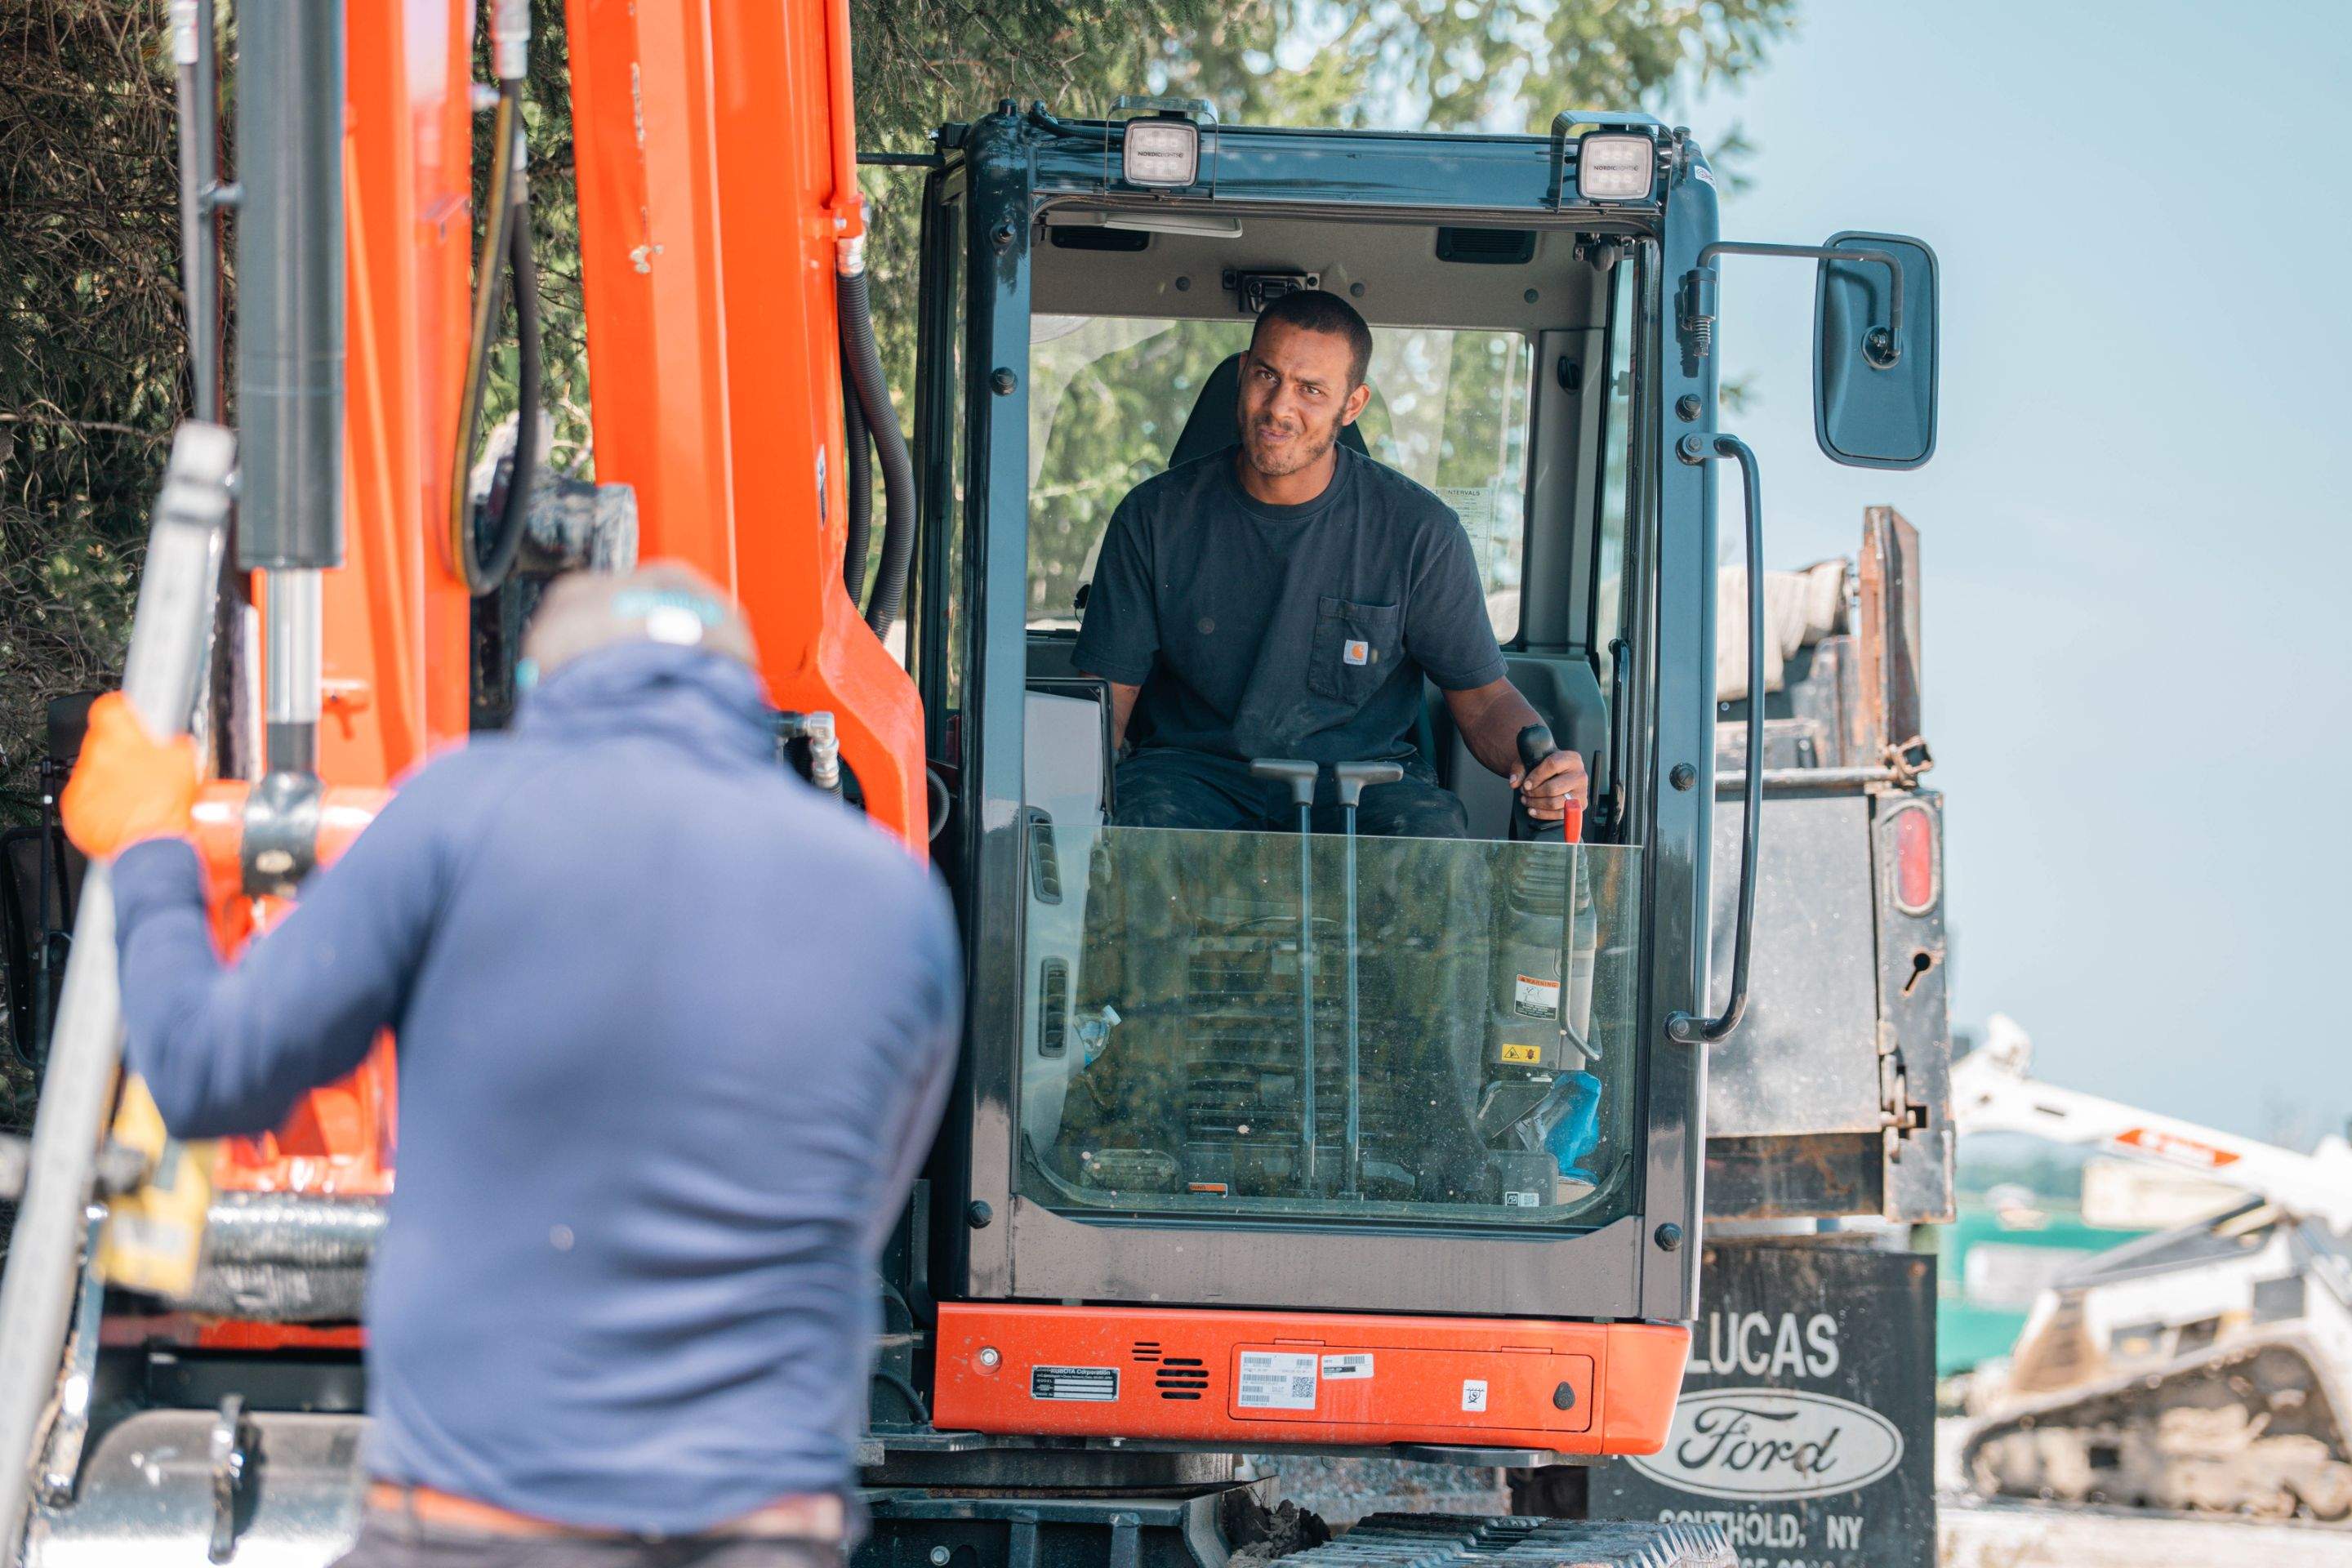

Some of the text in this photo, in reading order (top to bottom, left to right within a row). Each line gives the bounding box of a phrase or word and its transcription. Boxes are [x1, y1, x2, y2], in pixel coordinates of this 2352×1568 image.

[1526, 978, 1558, 987] WARNING
[1685, 1312, 1839, 1378] LUCAS
[1677, 1405, 1841, 1473] Ford
[1827, 1515, 1864, 1550] NY
